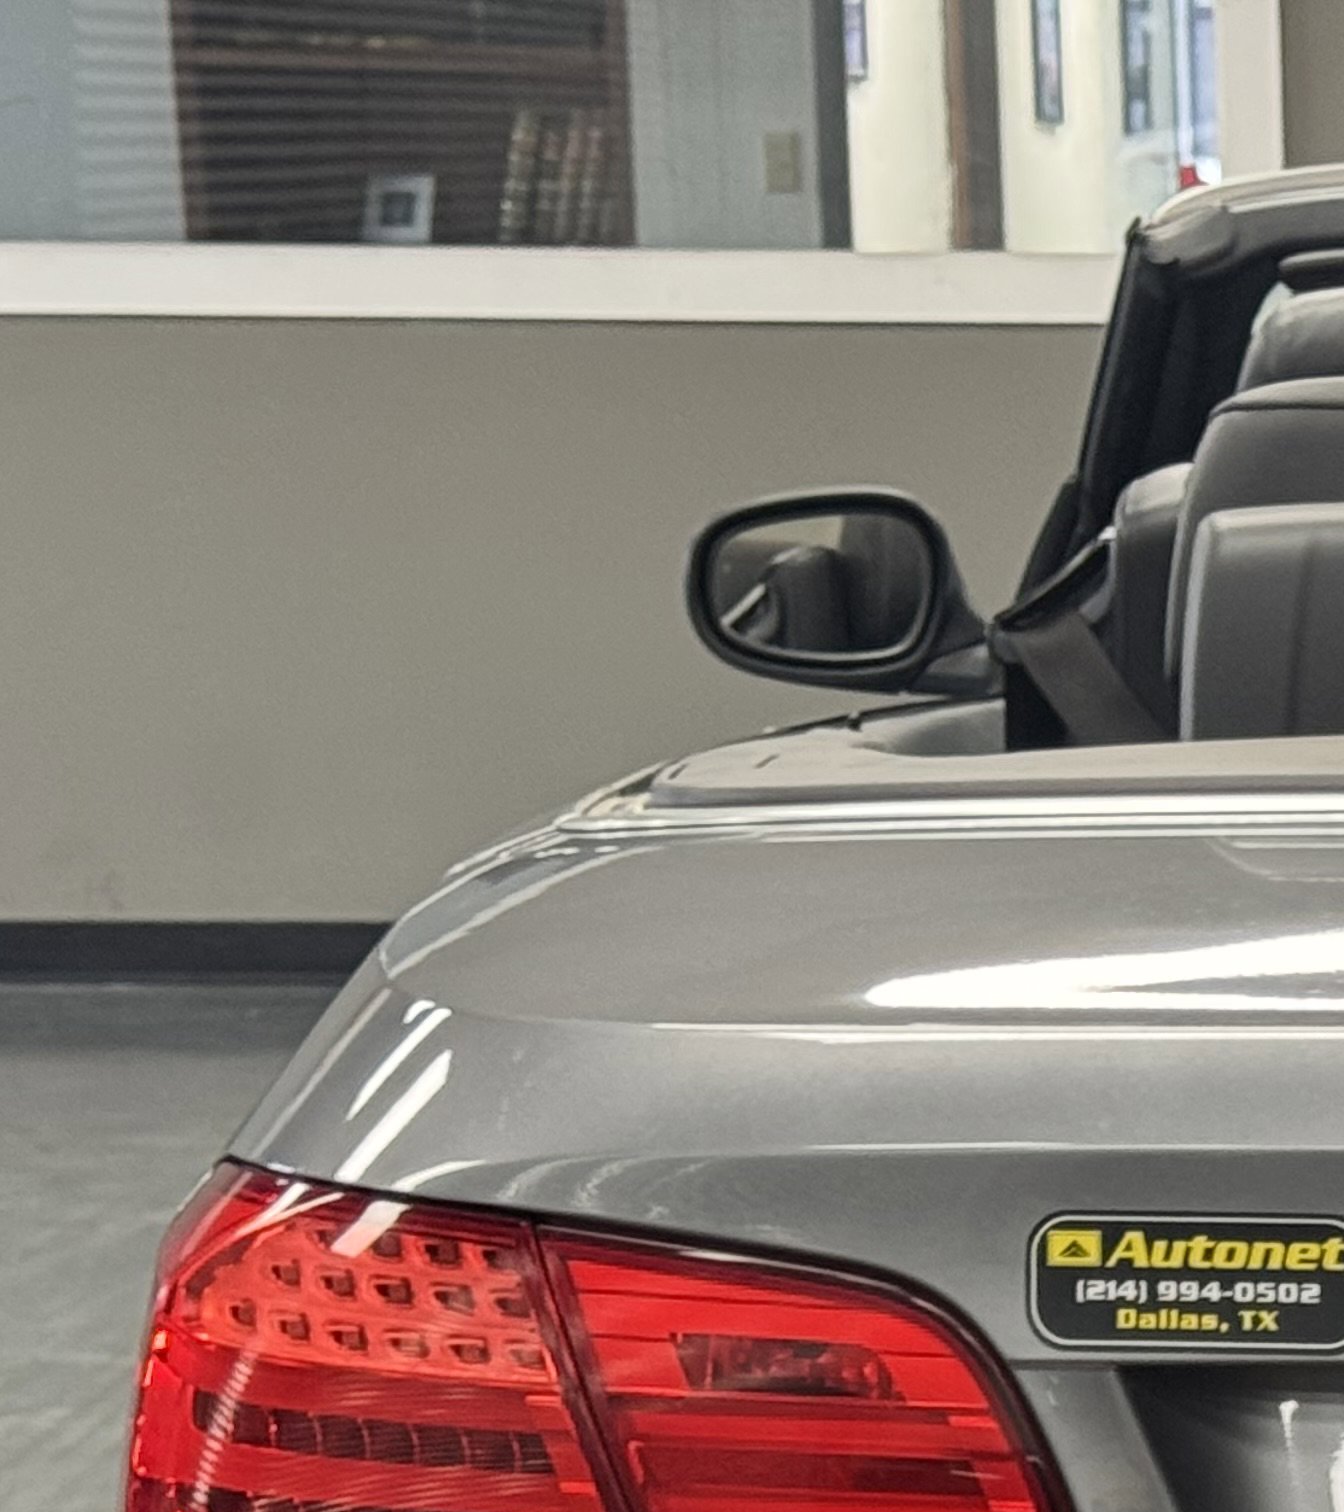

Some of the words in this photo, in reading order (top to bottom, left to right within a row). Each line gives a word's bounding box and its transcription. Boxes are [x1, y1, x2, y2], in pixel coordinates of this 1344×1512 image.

[1075, 1279, 1148, 1304] (214)
[1157, 1280, 1322, 1304] 994-0502
[1115, 1308, 1230, 1333] Dallas,
[1237, 1310, 1280, 1332] TX
